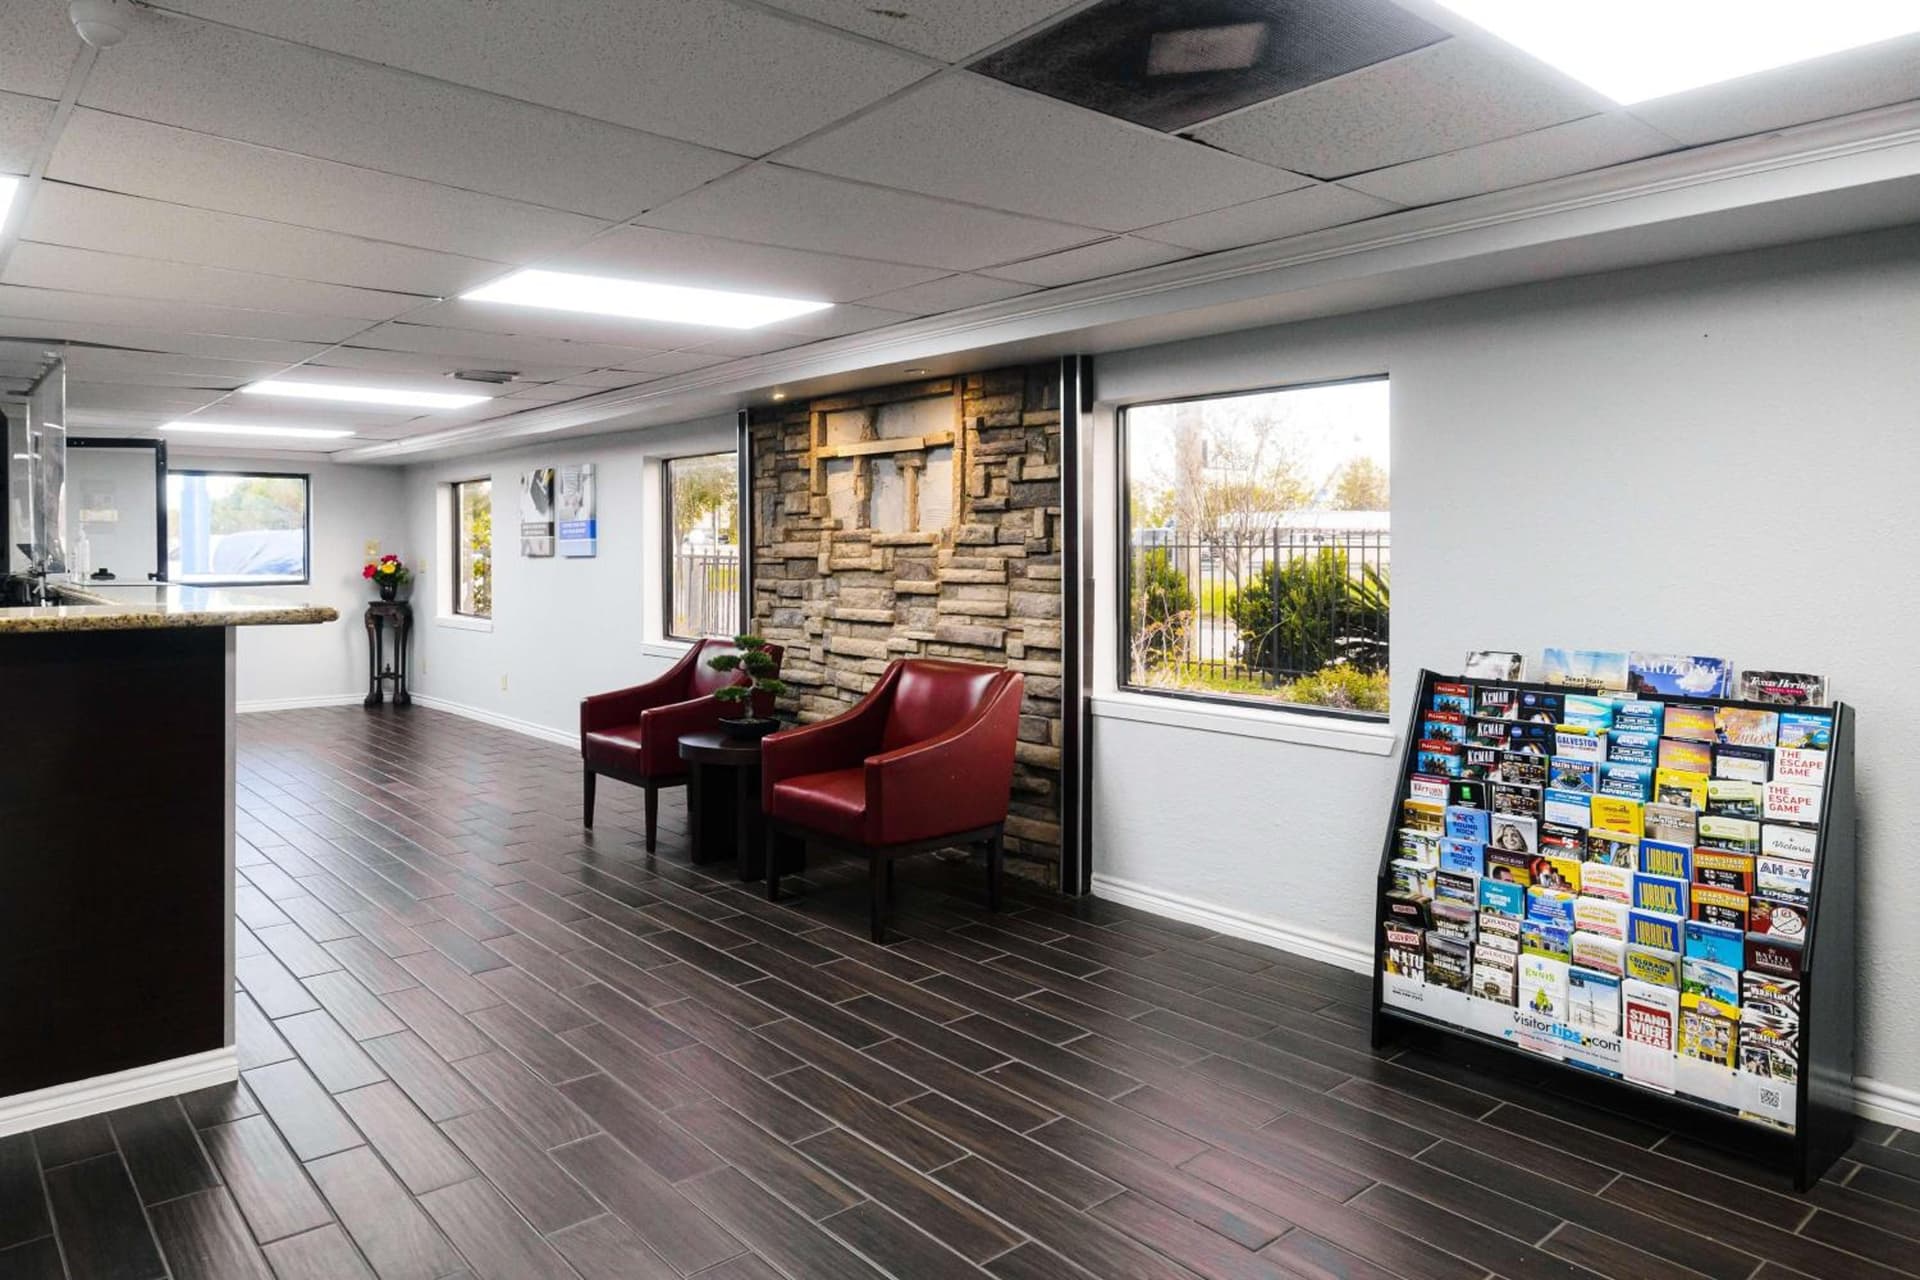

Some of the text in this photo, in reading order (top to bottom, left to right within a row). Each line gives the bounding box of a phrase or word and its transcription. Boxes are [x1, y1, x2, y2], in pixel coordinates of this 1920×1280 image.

[1637, 660, 1716, 676] ARIZONA
[1615, 723, 1657, 732] ADVENTURE
[1557, 735, 1599, 748] GALVESTON
[1609, 754, 1652, 764] ADVENTURE
[1780, 750, 1800, 759] THE
[1779, 760, 1823, 770] ESCAPE
[1779, 768, 1811, 777] GAME
[1600, 787, 1644, 798] ADVENTURE
[1768, 786, 1790, 795] THE
[1768, 795, 1812, 806] ESCAPE
[1768, 803, 1801, 814] GAME
[1452, 821, 1478, 831] ROUND
[1456, 828, 1475, 836] ROCK
[1772, 840, 1812, 854] Victoria
[1450, 853, 1476, 862] ROUND
[1646, 847, 1685, 878] LUBBOCK
[1453, 859, 1472, 868] ROCK
[1639, 882, 1678, 911] LUBBOCK
[1635, 920, 1674, 949] LUBBOCK
[1629, 1009, 1668, 1027] STAND
[1630, 1022, 1669, 1040] WHERE
[1630, 1032, 1669, 1049] TEXAS
